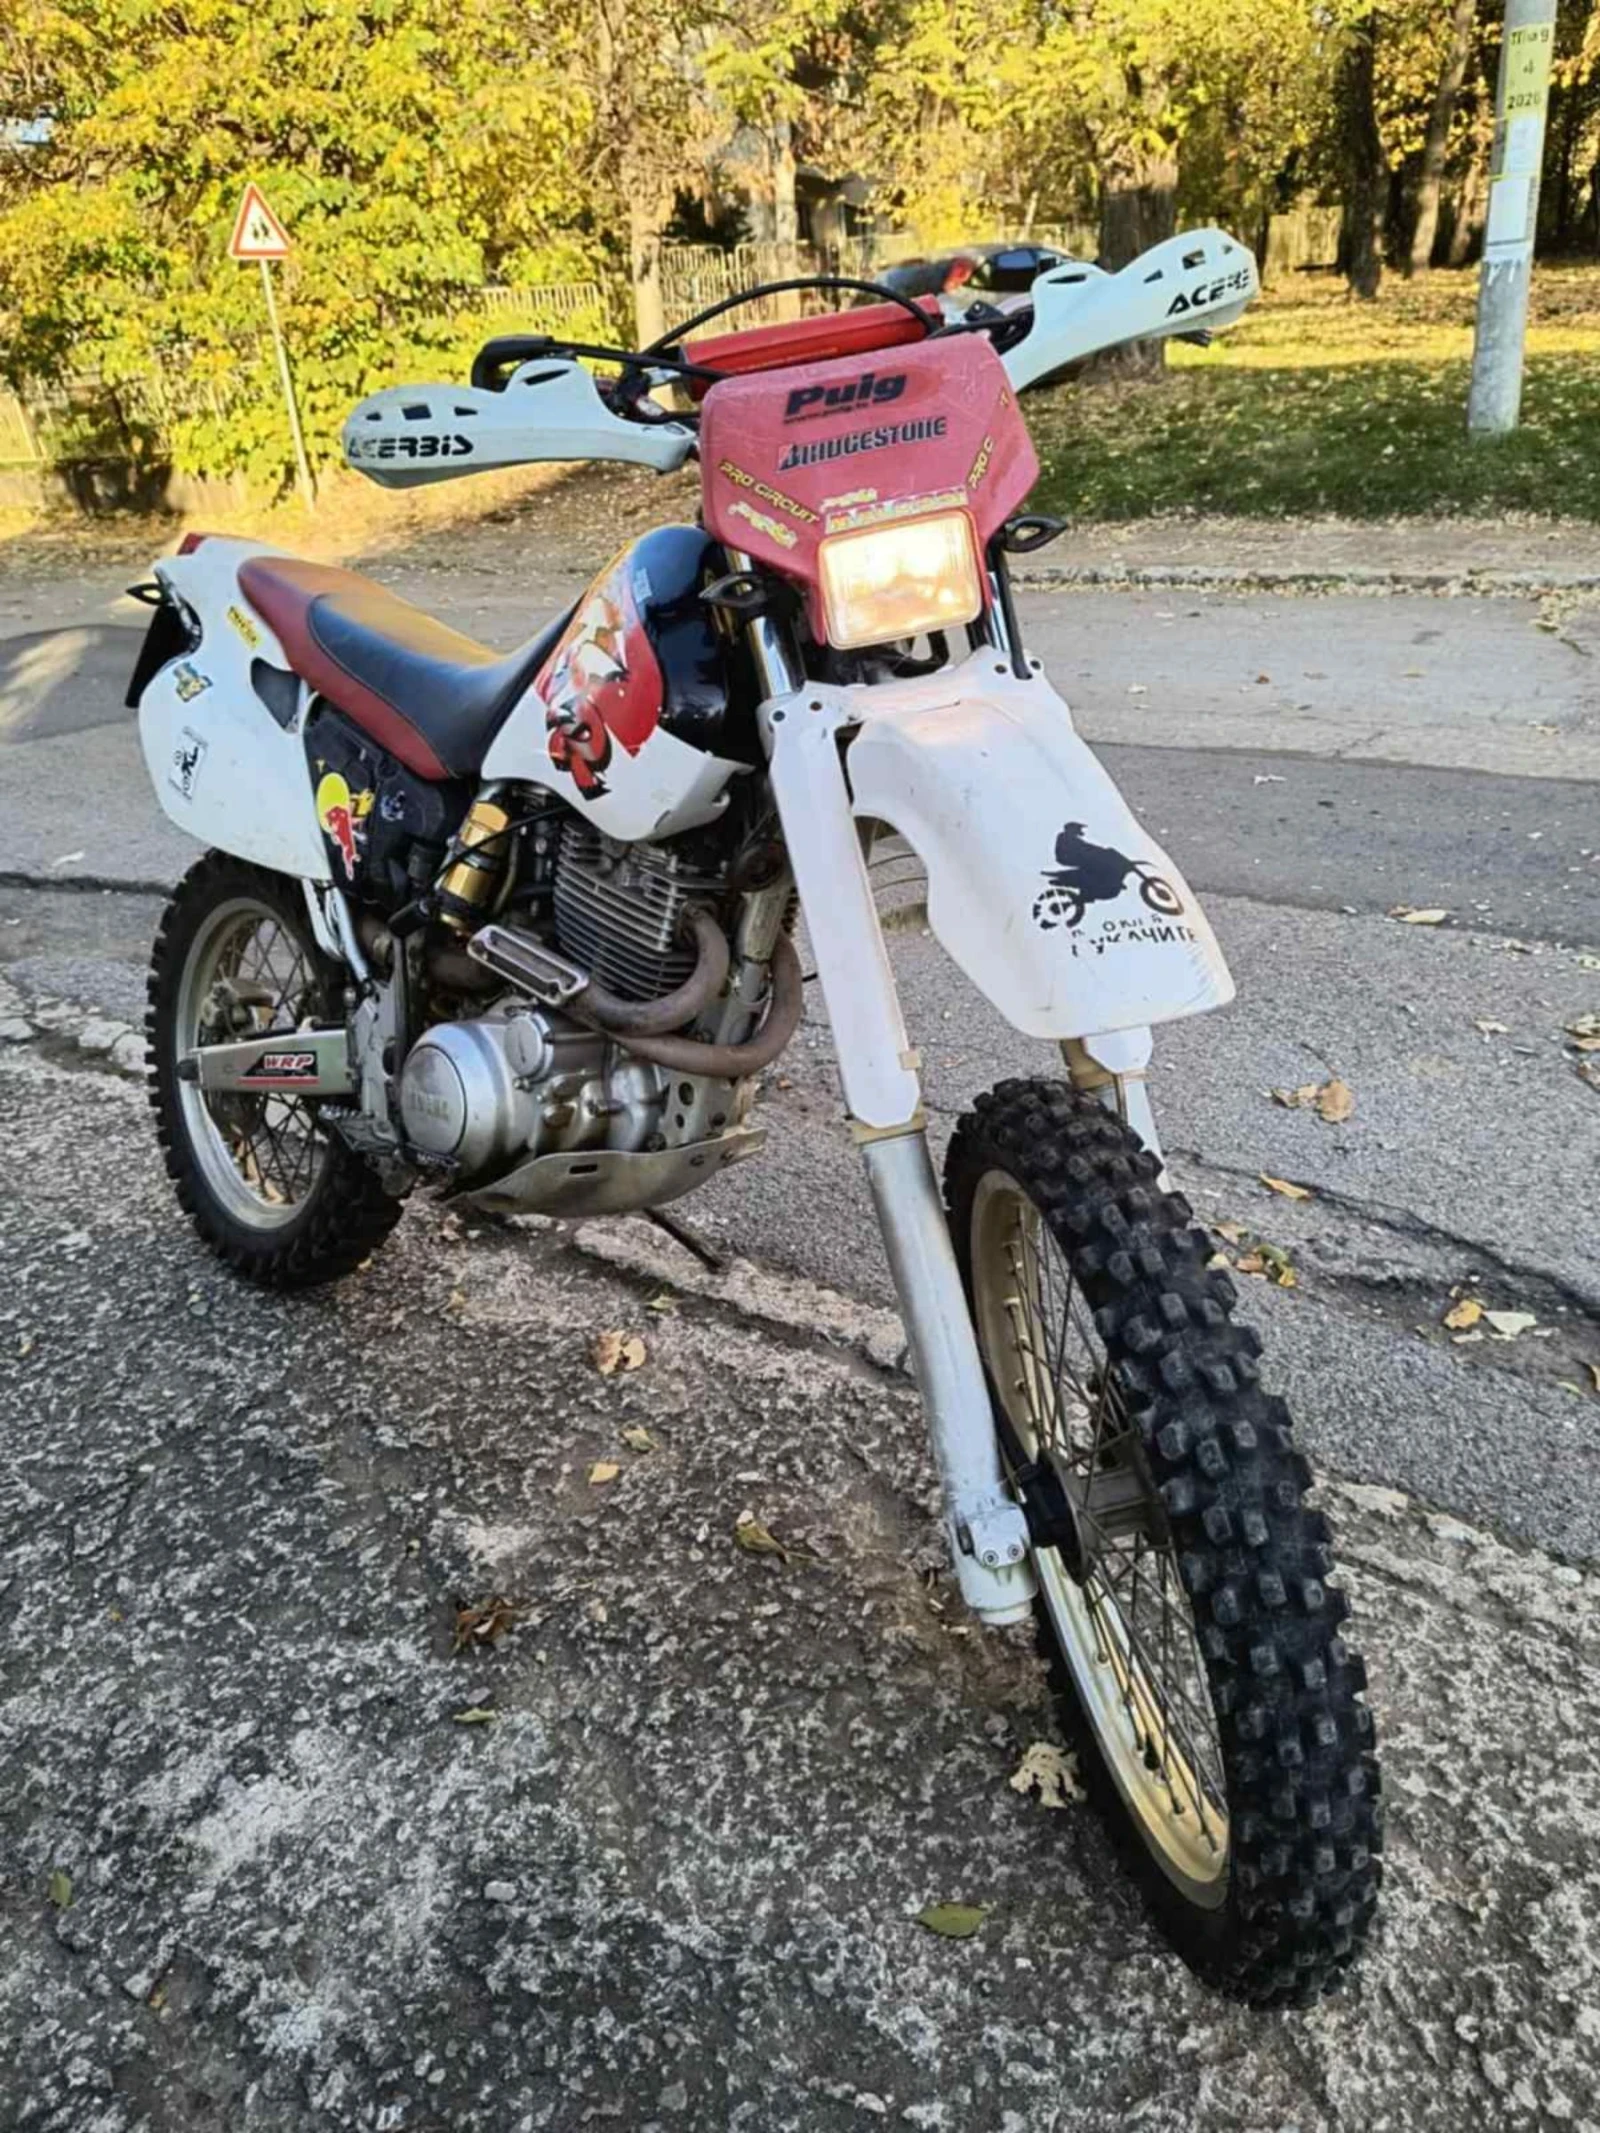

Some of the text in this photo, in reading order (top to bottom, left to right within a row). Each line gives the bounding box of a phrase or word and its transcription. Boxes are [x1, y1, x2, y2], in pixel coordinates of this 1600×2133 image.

[784, 373, 907, 417] Puig
[779, 416, 946, 471] BRIDGESTONE
[720, 461, 754, 487] PRO
[754, 483, 819, 524] CIRCUIT
[264, 1054, 315, 1069] WRP
